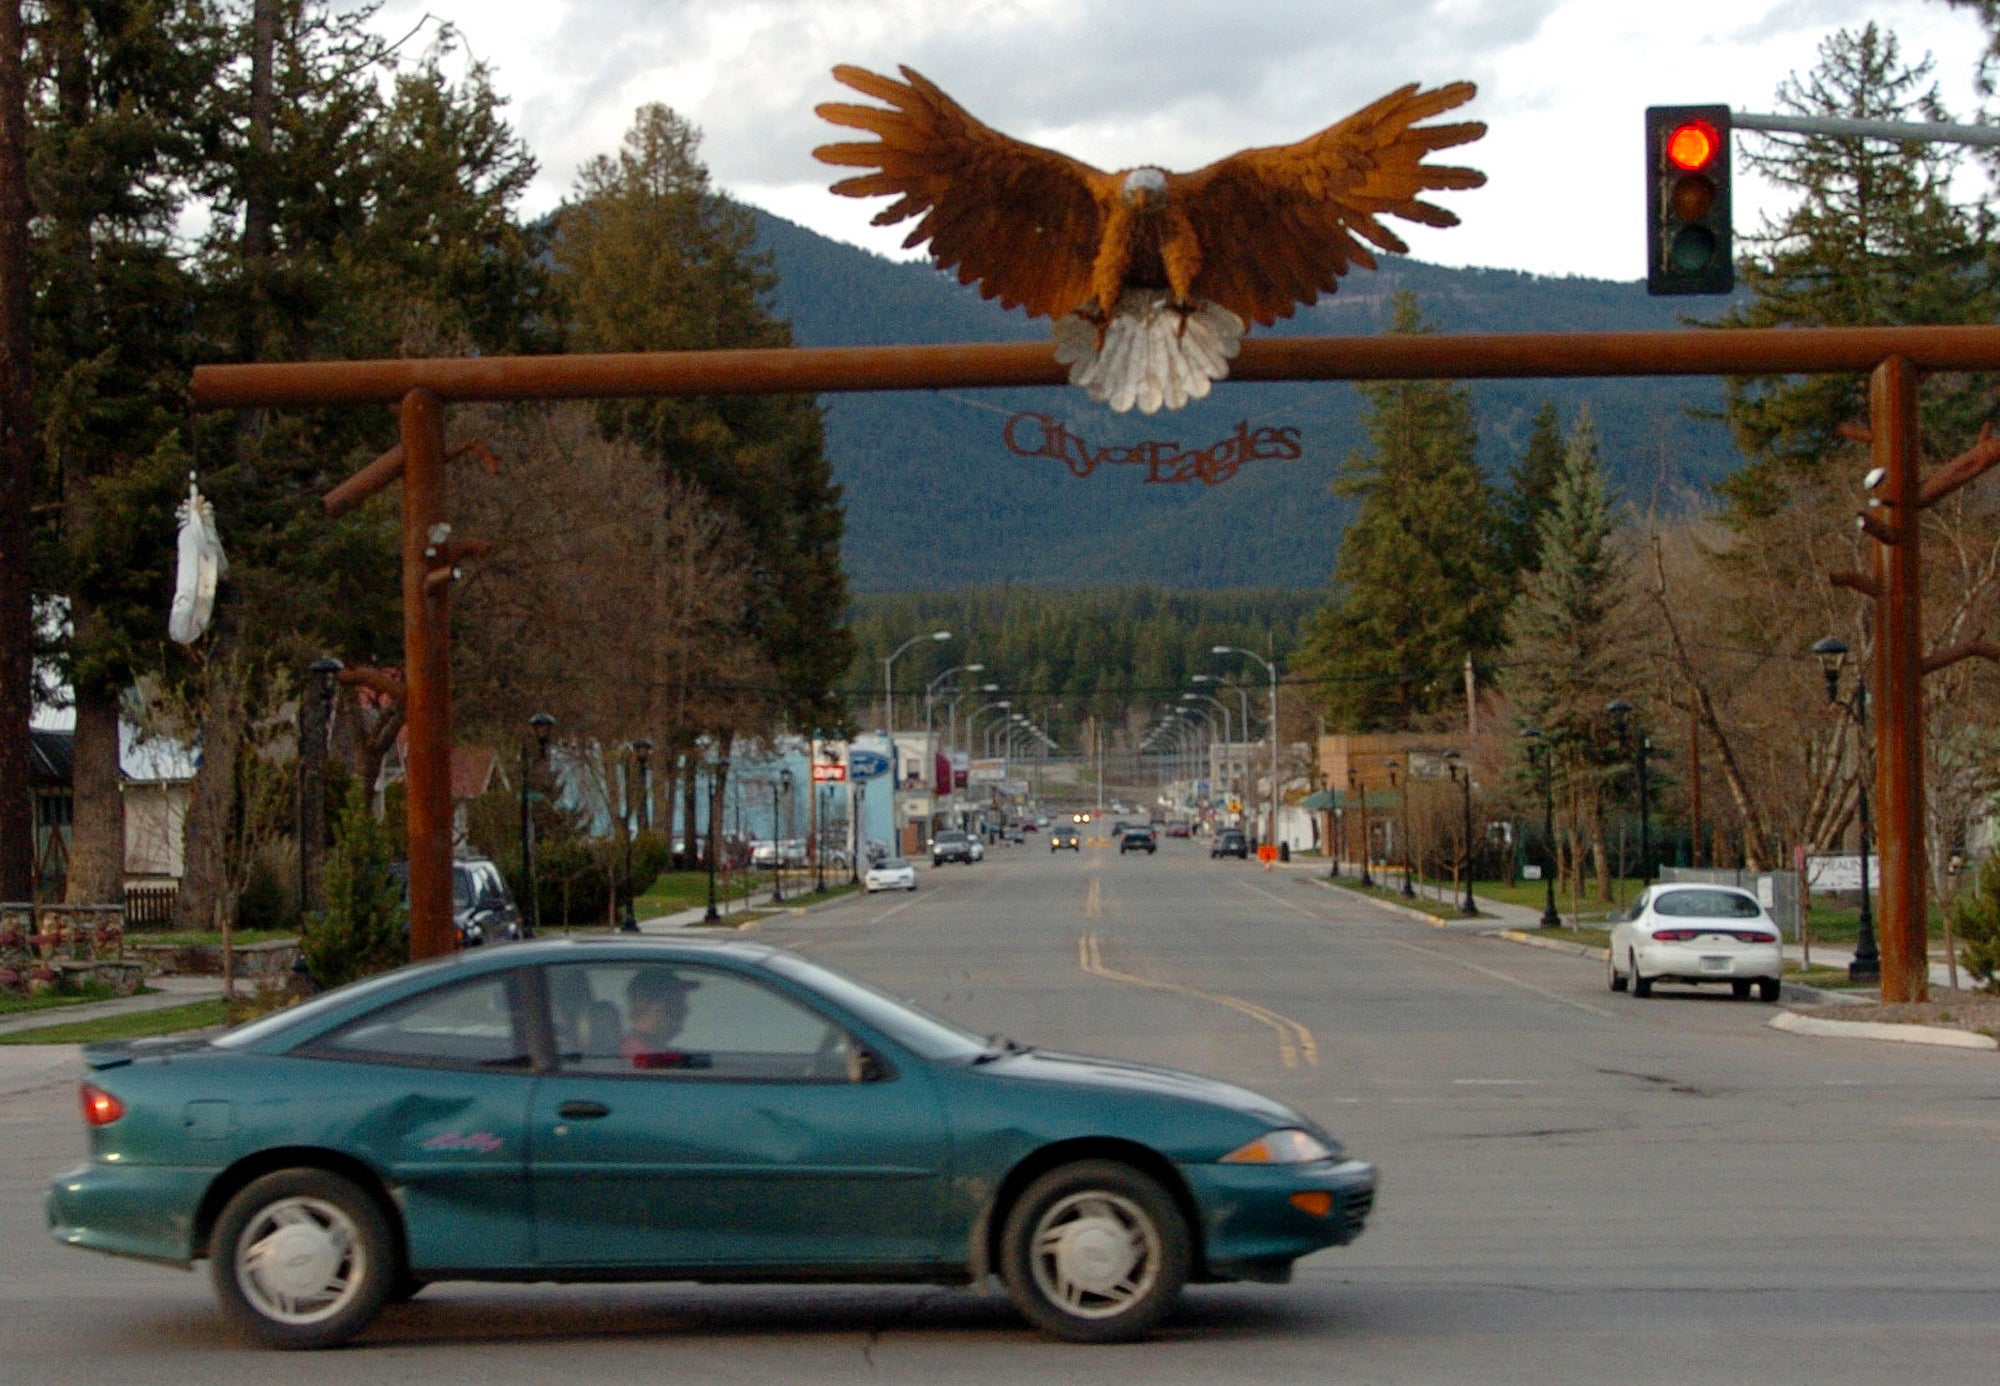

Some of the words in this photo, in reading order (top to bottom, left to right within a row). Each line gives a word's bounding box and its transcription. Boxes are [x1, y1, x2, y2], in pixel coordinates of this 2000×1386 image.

[1003, 411, 1102, 478] City
[1099, 440, 1150, 464] of
[1144, 419, 1302, 485] Eagles
